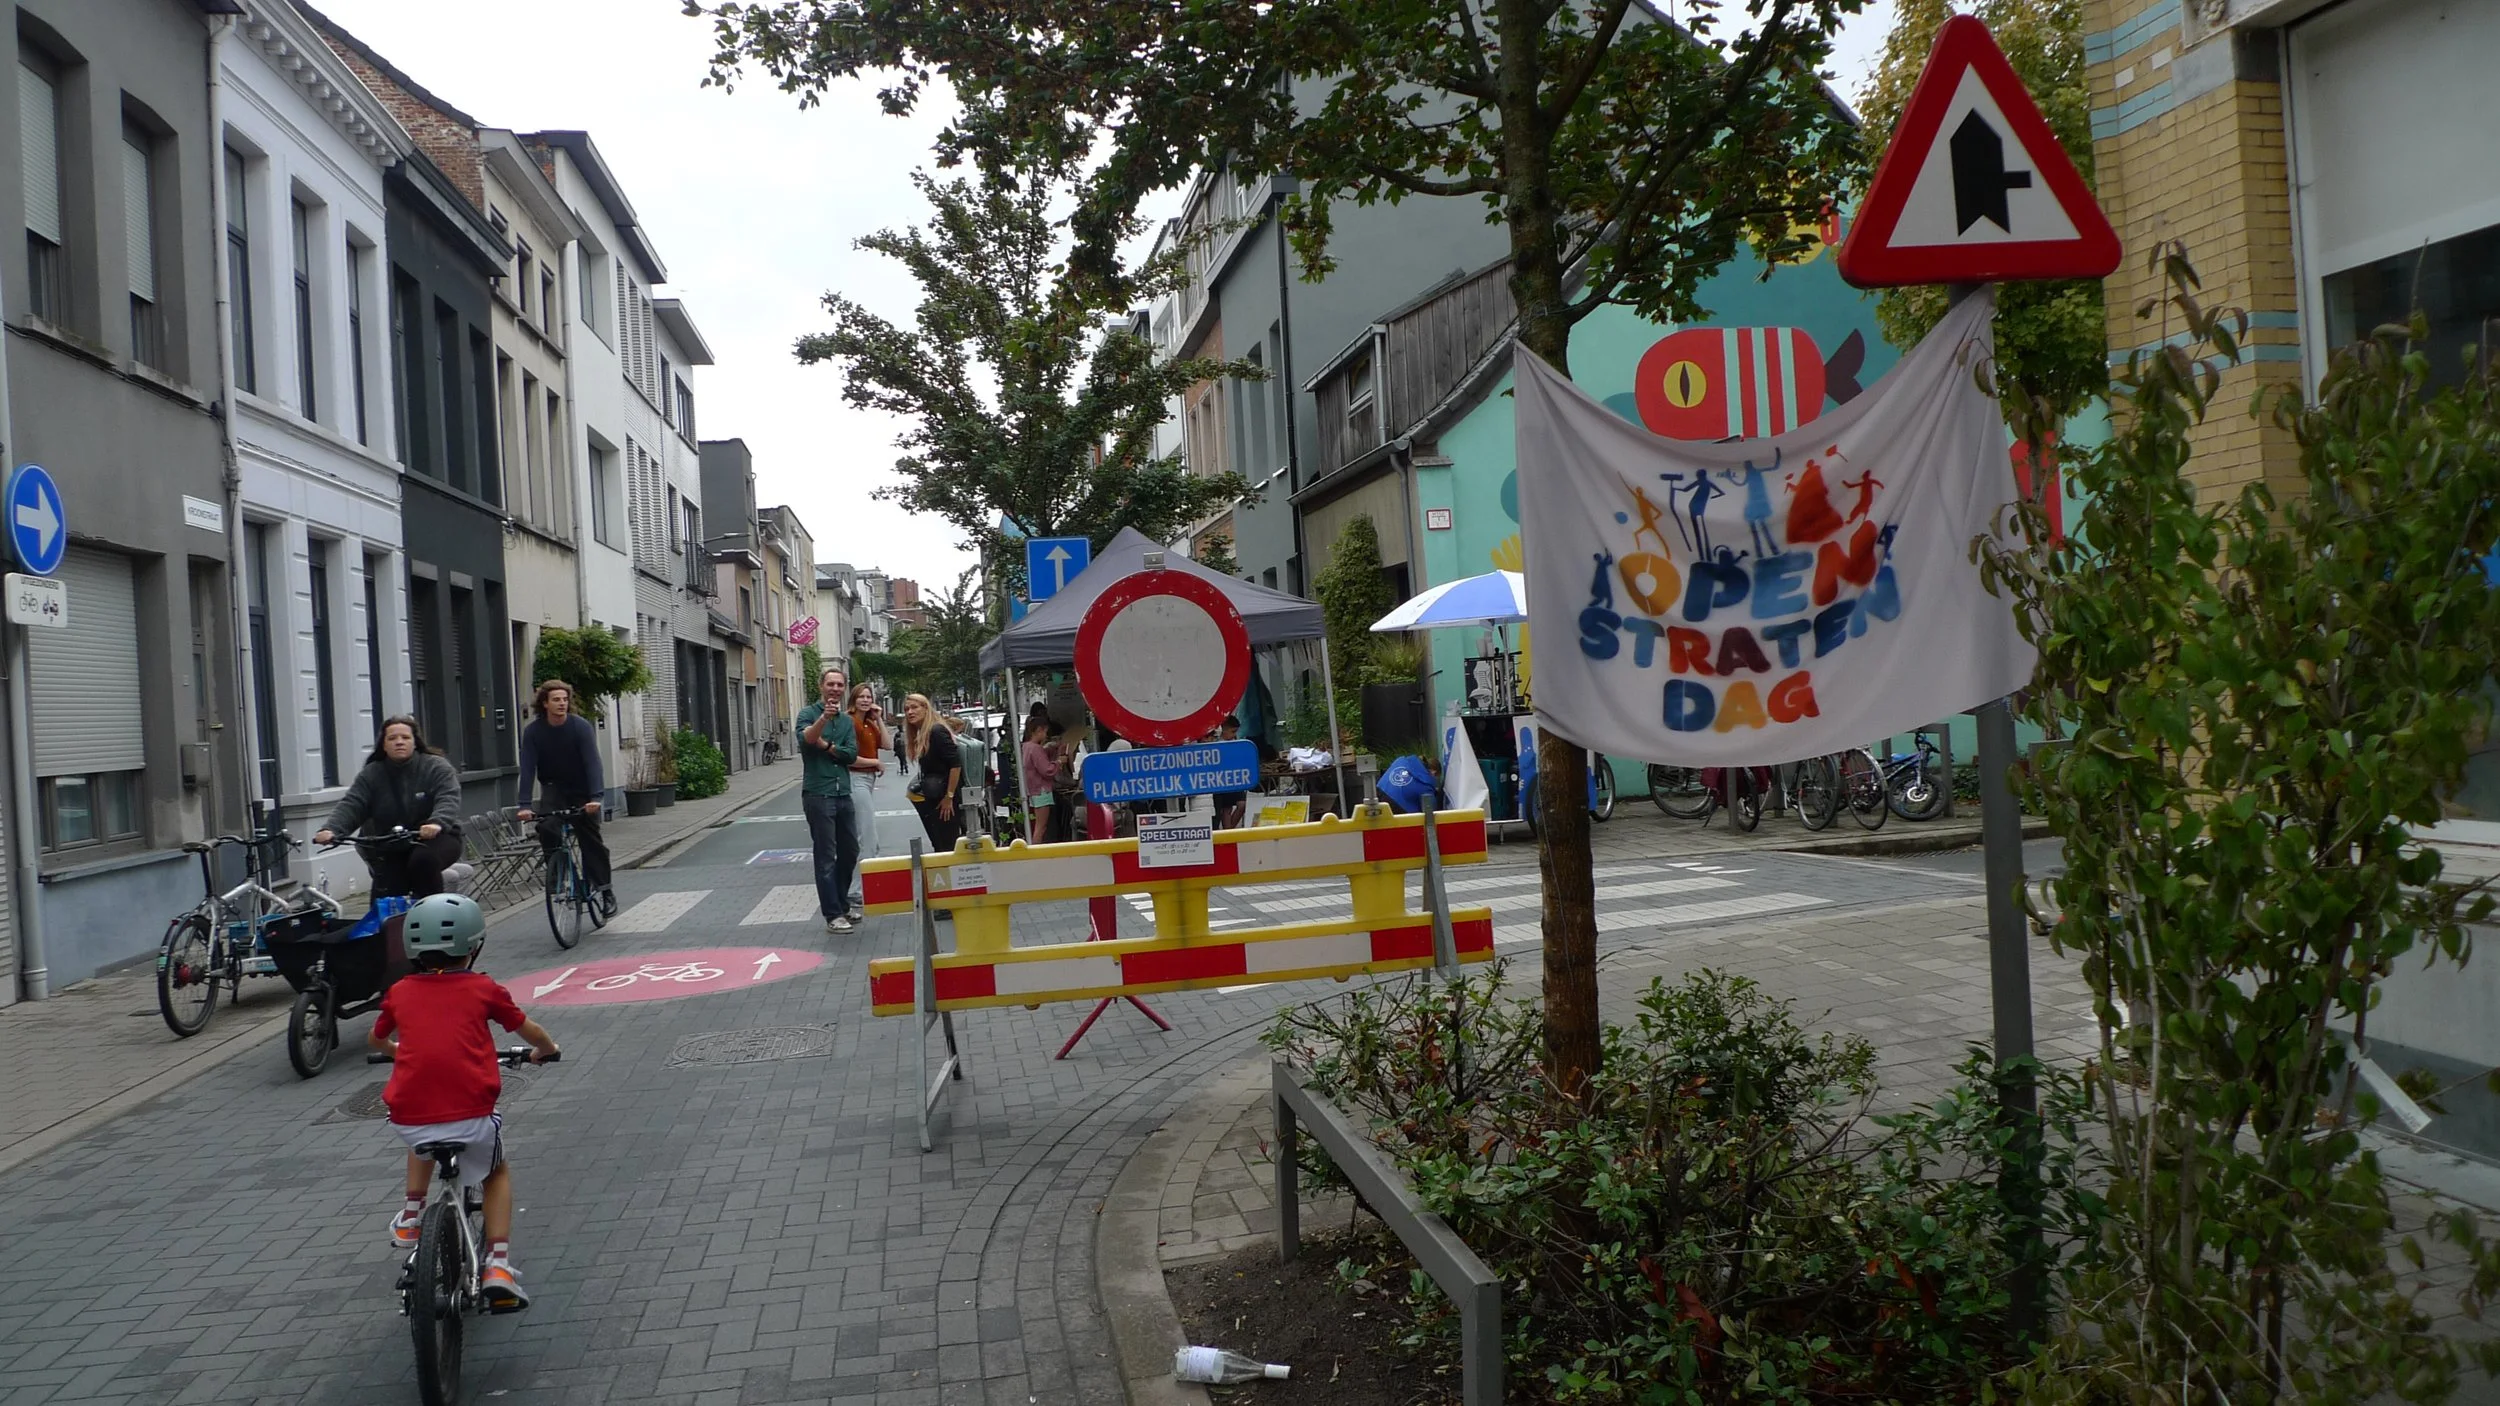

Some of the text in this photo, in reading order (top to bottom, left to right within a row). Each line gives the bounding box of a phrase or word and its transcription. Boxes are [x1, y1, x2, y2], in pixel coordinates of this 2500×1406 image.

[1618, 520, 1877, 622] OPEN
[791, 618, 816, 639] WALLS
[1579, 565, 1900, 676] STRATEN
[1663, 670, 1820, 733] DAG
[1120, 748, 1221, 773] UITGEZONDERD
[1093, 769, 1251, 798] PLAATSELIJK VERKEER
[1141, 829, 1209, 841] SPEELSTRAAT
[933, 872, 946, 888] A
